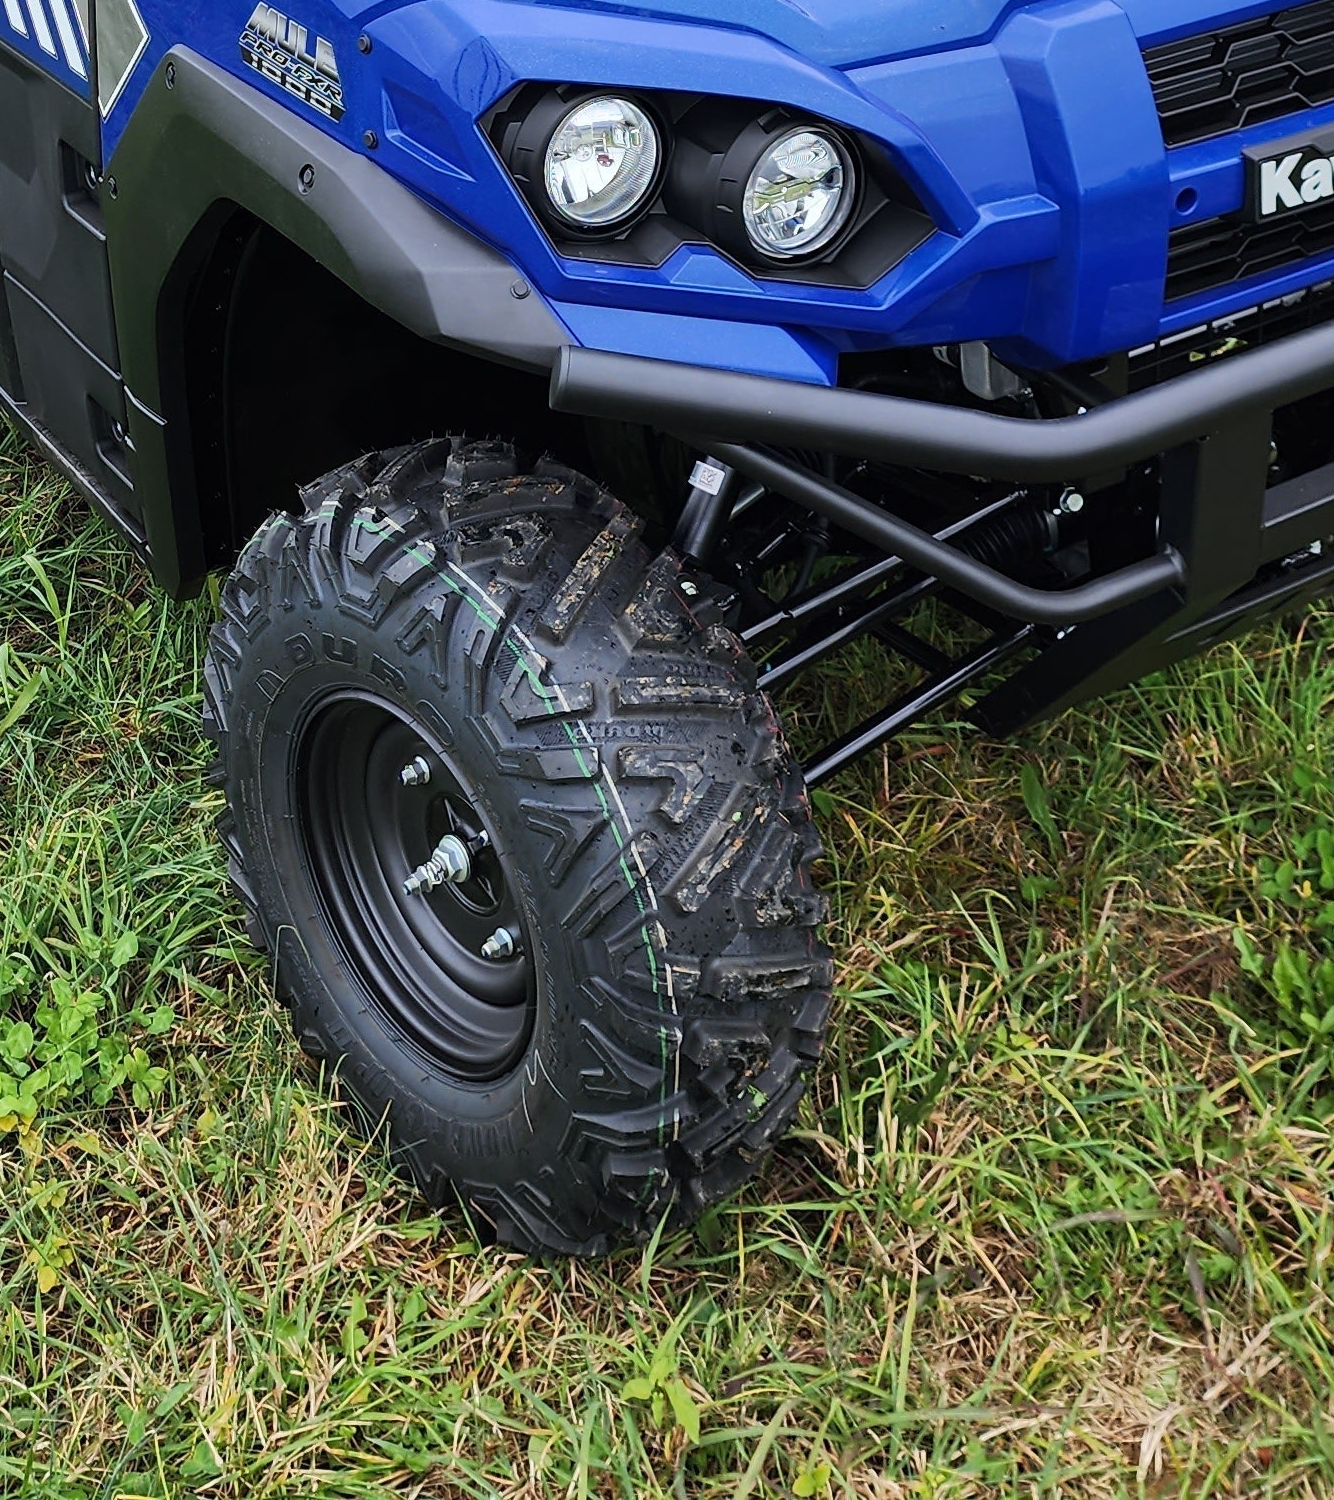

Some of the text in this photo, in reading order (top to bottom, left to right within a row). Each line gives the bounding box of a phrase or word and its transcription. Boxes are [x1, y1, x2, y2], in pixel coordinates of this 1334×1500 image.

[238, 31, 344, 106] PRO-FXR
[244, 1, 341, 87] MULE
[250, 53, 333, 115] 1000
